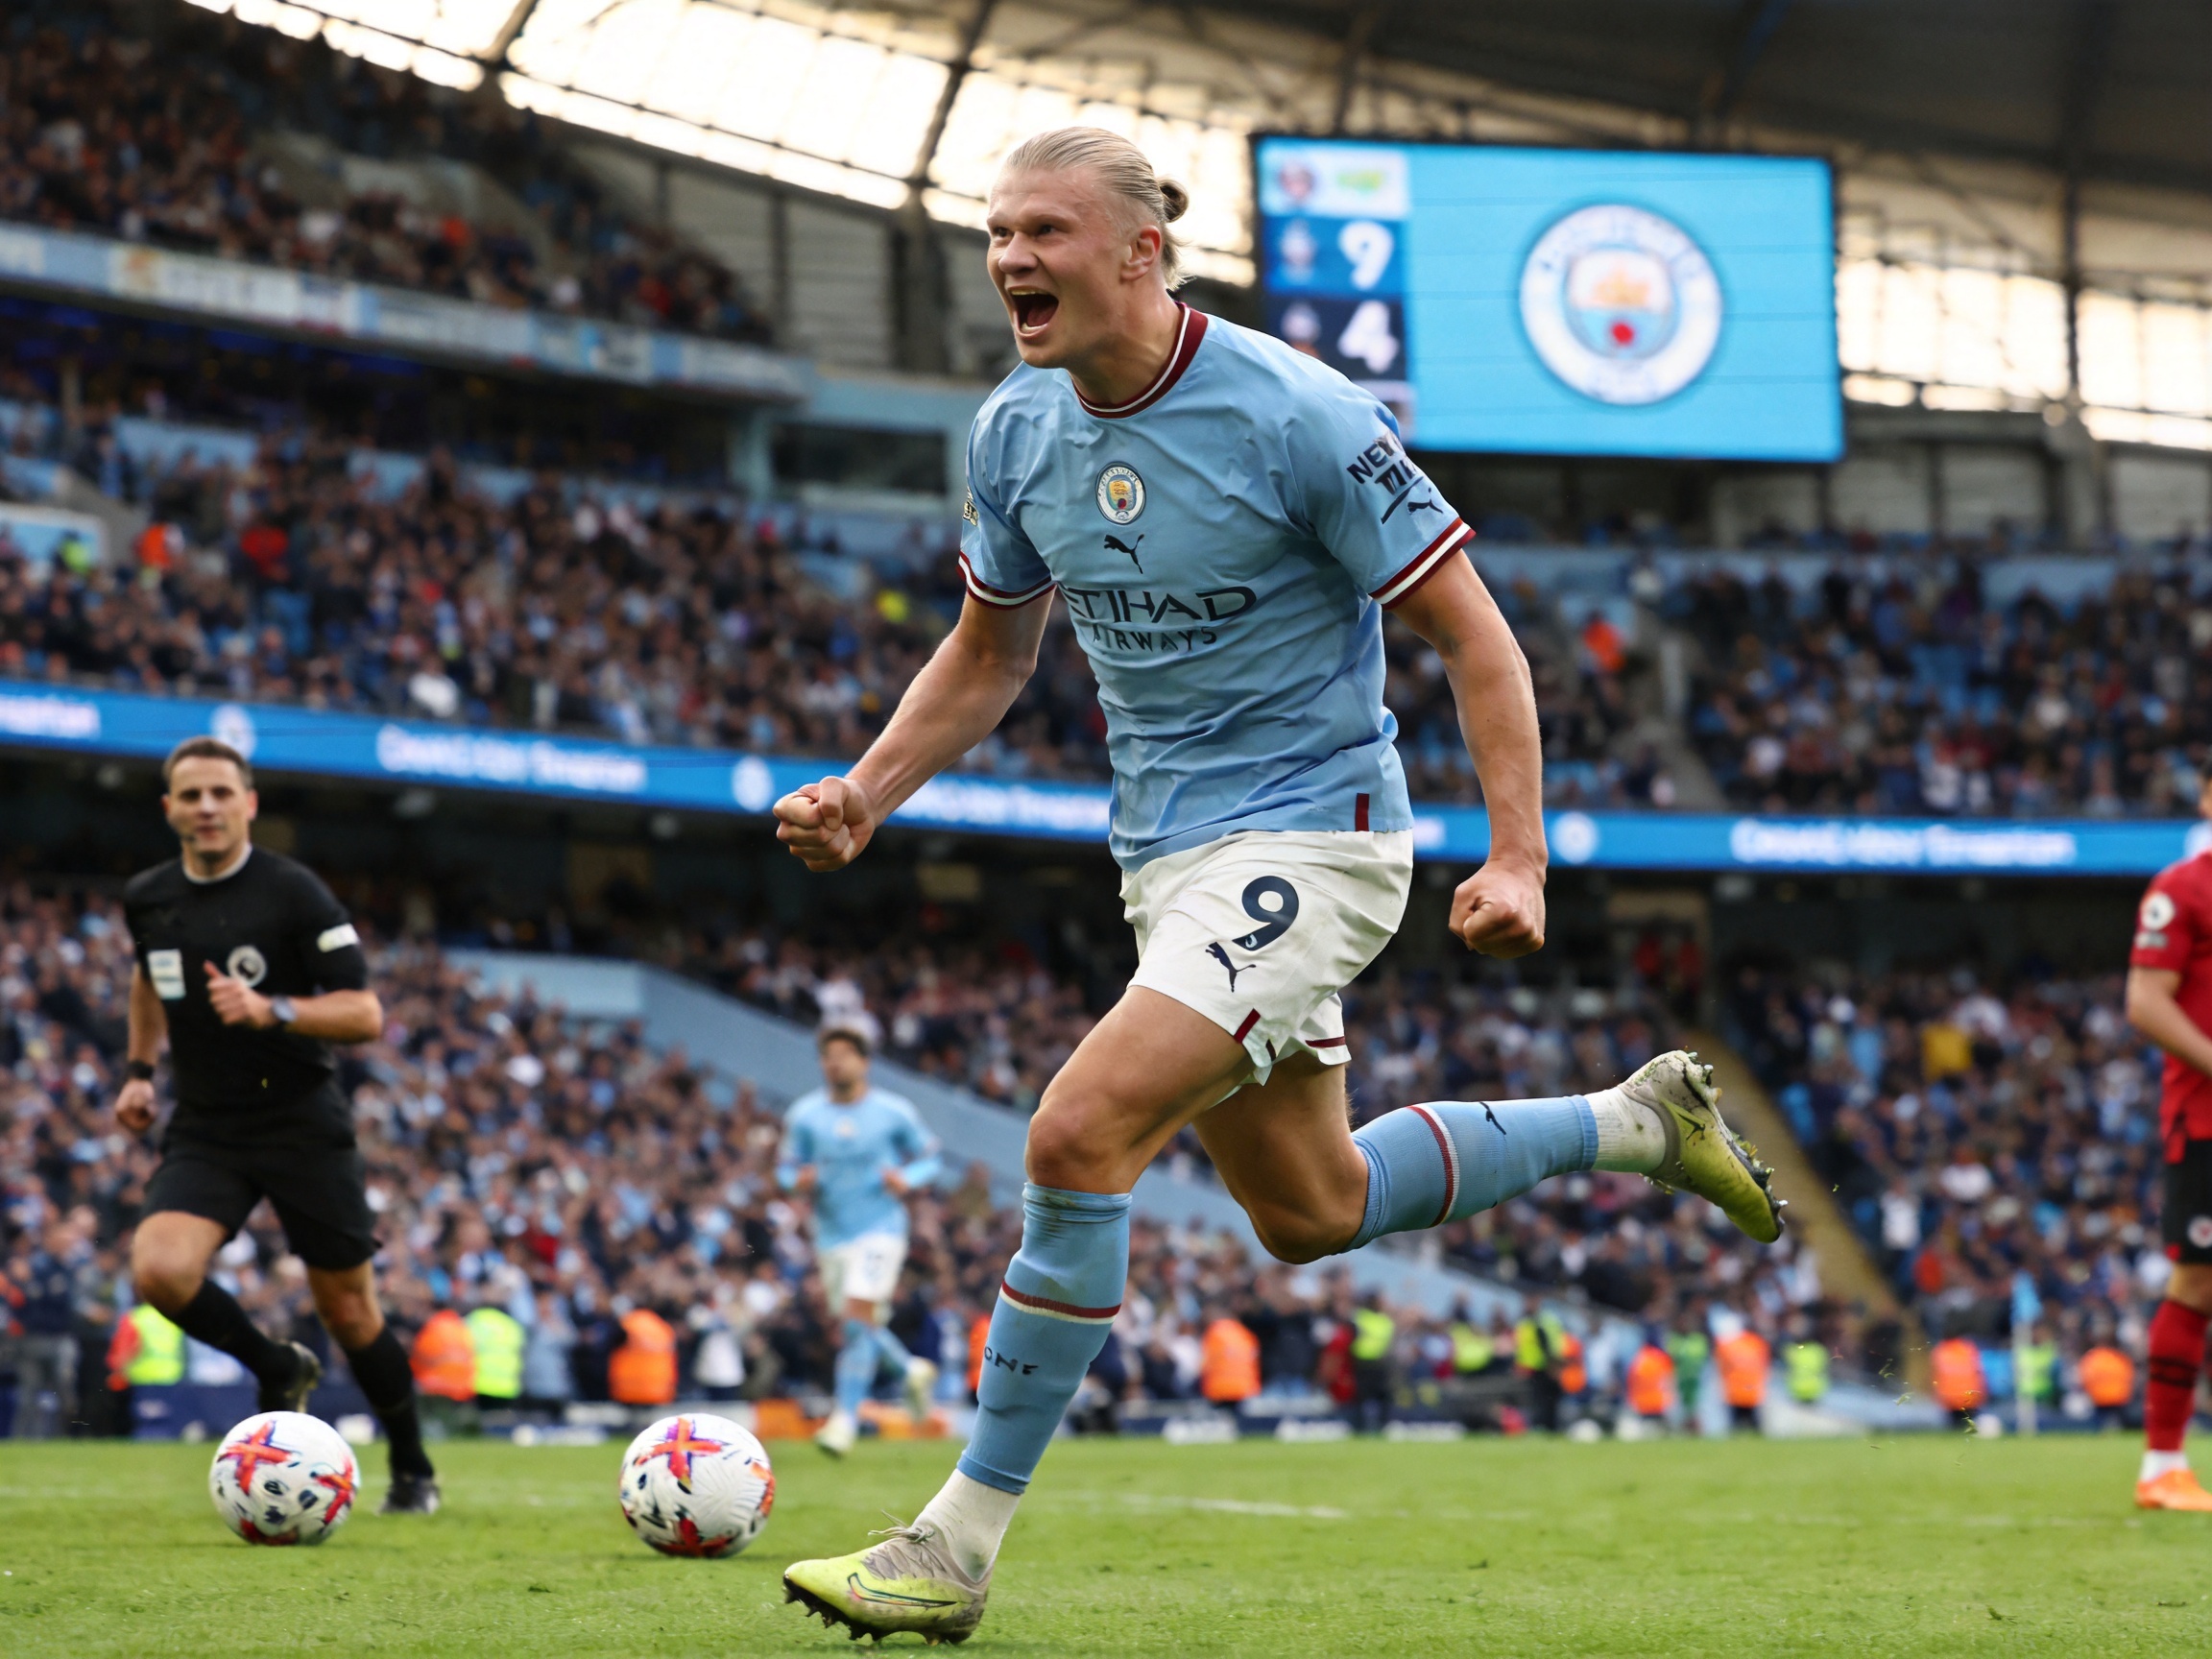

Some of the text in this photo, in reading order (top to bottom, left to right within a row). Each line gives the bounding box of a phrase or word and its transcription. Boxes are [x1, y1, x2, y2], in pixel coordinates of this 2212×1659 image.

[1338, 220, 1394, 290] 9
[1337, 300, 1400, 374] 4
[1232, 875, 1300, 951] 9
